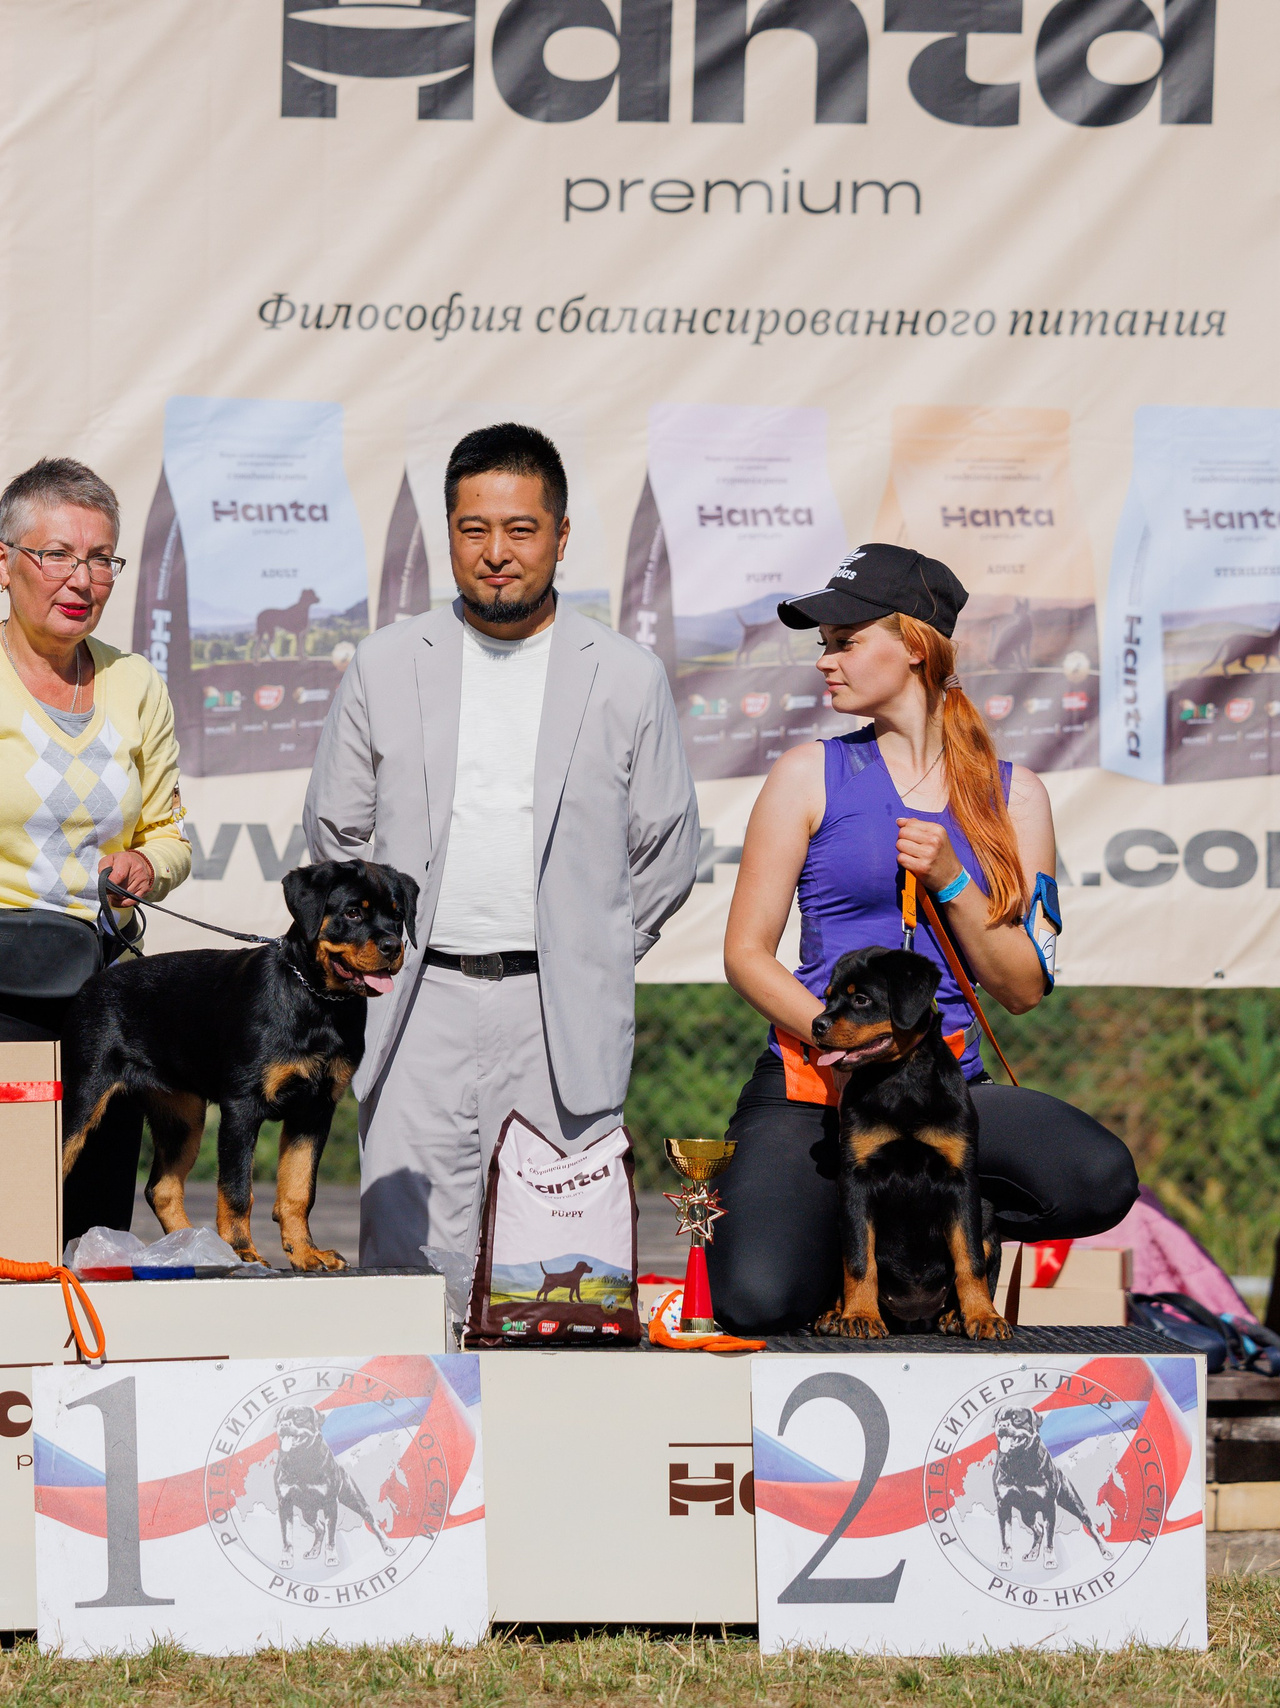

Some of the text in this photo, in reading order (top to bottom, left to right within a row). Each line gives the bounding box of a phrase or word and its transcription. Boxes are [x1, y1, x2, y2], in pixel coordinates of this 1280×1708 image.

[563, 170, 923, 222] premium
[258, 290, 1227, 346] Философия сбалансированного питания
[212, 499, 328, 521] Hanta
[698, 504, 814, 526] Hanta
[941, 504, 1055, 528] Hanta
[1184, 507, 1280, 530] Hant
[1123, 614, 1142, 760] Hanta
[517, 1164, 611, 1194] anta
[551, 1209, 584, 1218] PUPPY
[207, 1371, 447, 1548] РОТВЕЙЛЕР КЛУБ РОССИИ
[929, 1371, 1163, 1546] РОТВЕЙЛЕР КЛУБ РОССИИ
[65, 1376, 176, 1609] 1
[776, 1372, 906, 1604] 2
[267, 1565, 401, 1604] РКФ-НКПР
[987, 1569, 1118, 1607] РКФ-НКПР
